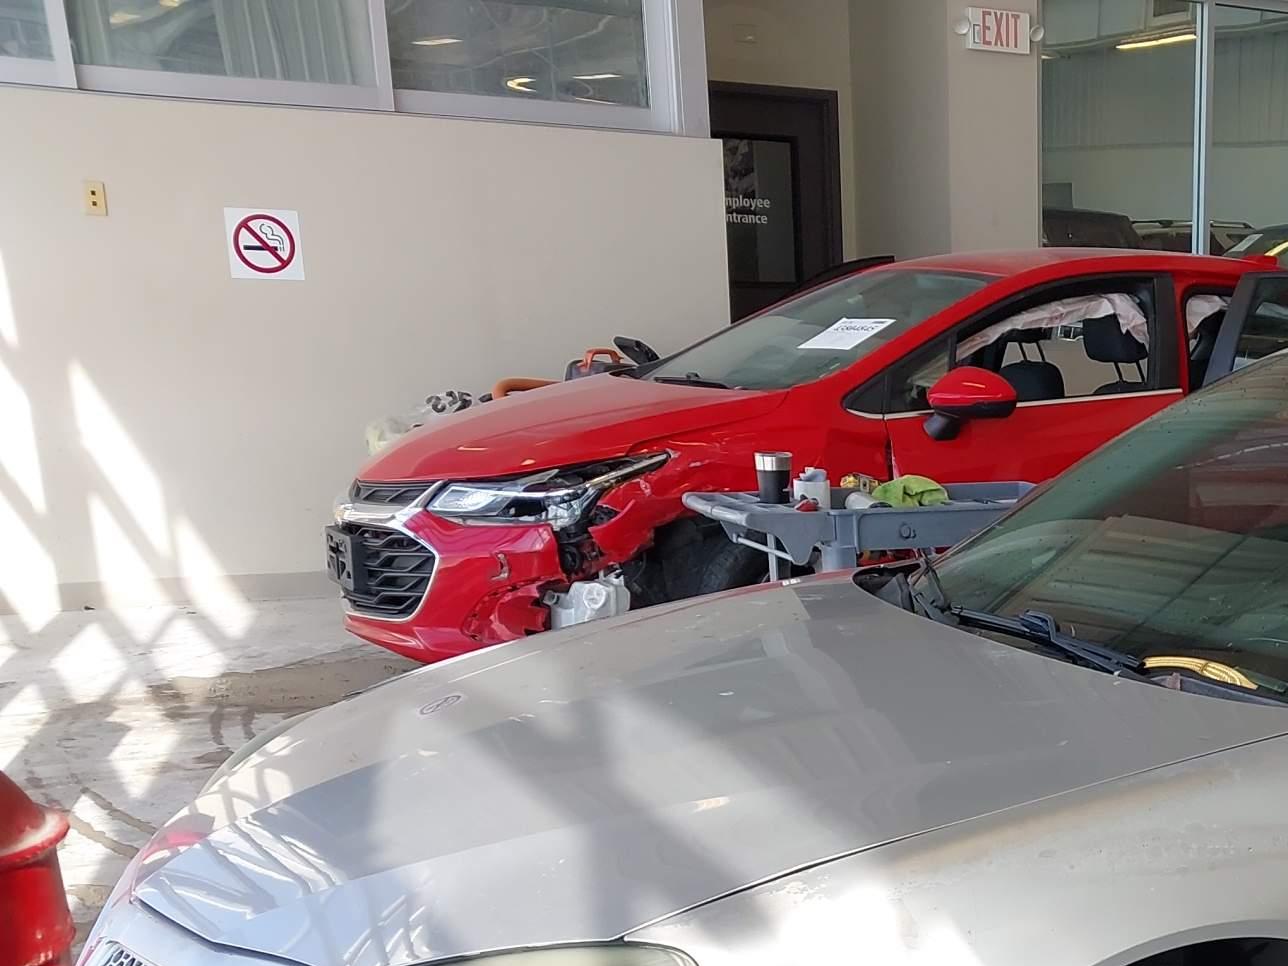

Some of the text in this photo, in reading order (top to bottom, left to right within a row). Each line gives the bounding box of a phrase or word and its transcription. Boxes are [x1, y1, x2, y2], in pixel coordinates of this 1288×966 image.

[982, 10, 1020, 48] EXIT
[725, 195, 770, 210] mployee
[726, 212, 768, 224] ntrance
